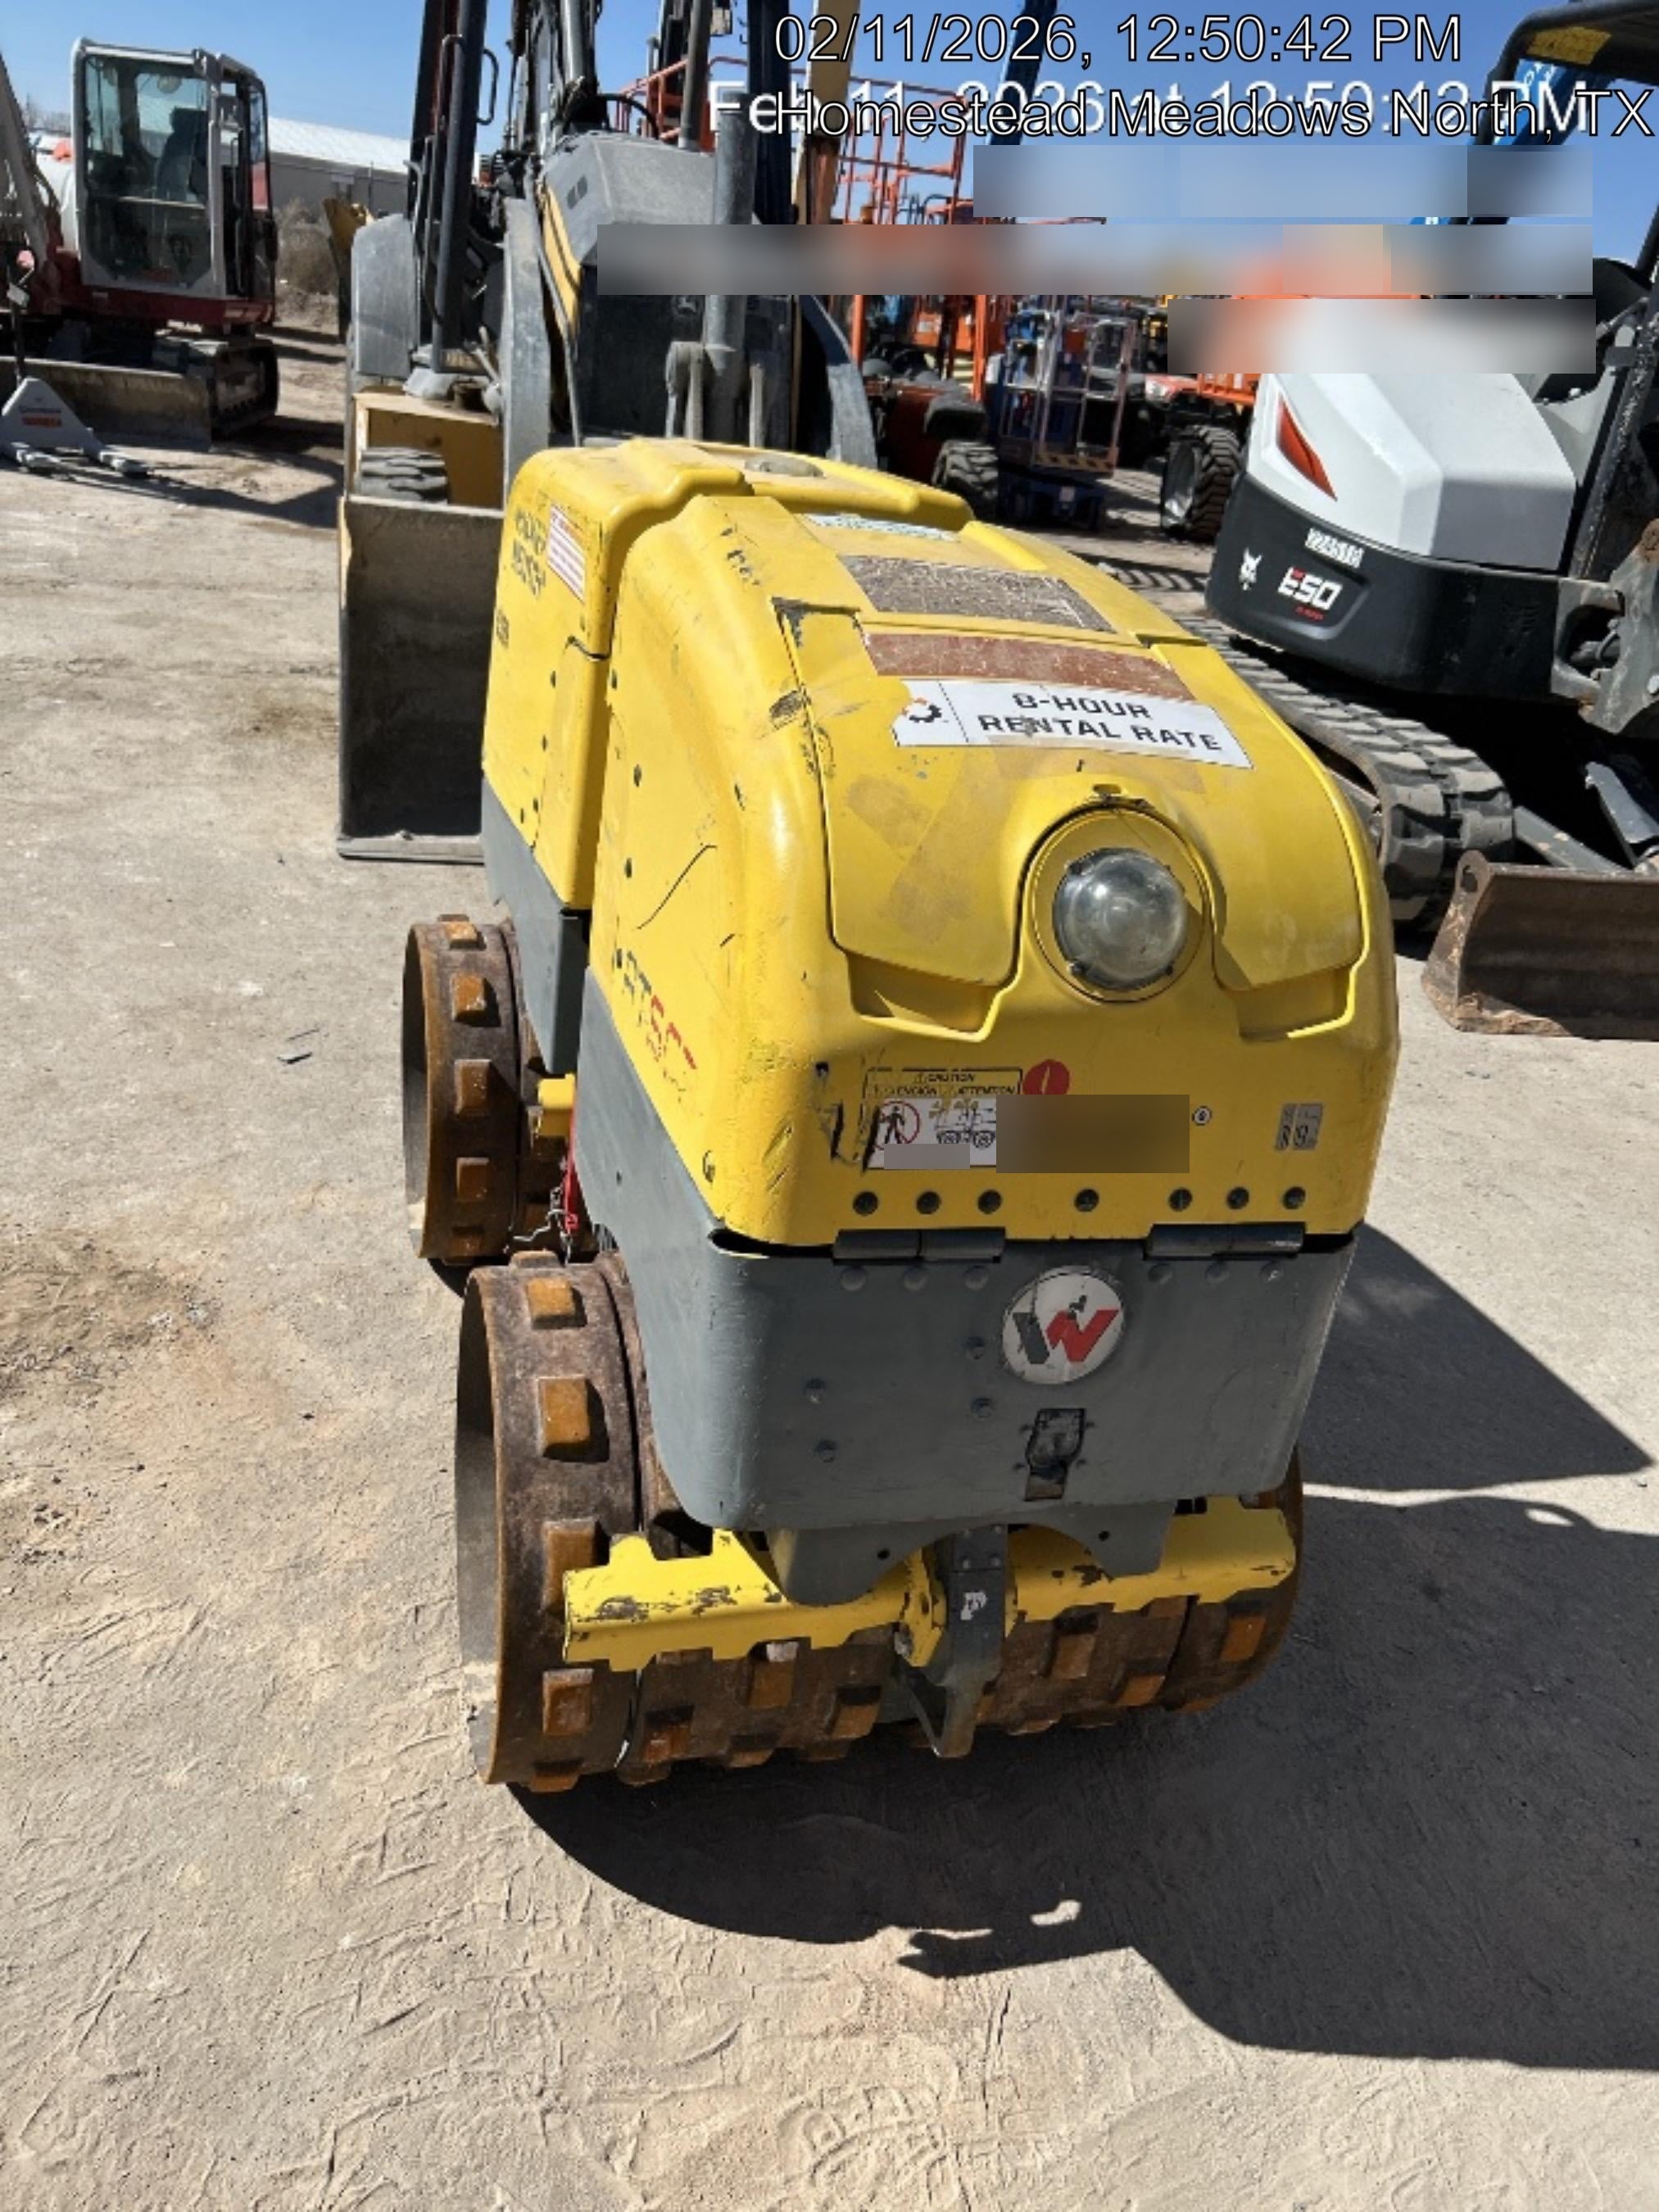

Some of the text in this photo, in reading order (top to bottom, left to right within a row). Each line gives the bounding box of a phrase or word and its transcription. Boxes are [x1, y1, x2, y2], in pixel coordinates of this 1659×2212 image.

[1277, 567, 1344, 610] E50
[1012, 692, 1151, 719] 8-HOUR
[977, 714, 1222, 750] RENTAL RATE
[927, 1072, 976, 1083] CAUTION
